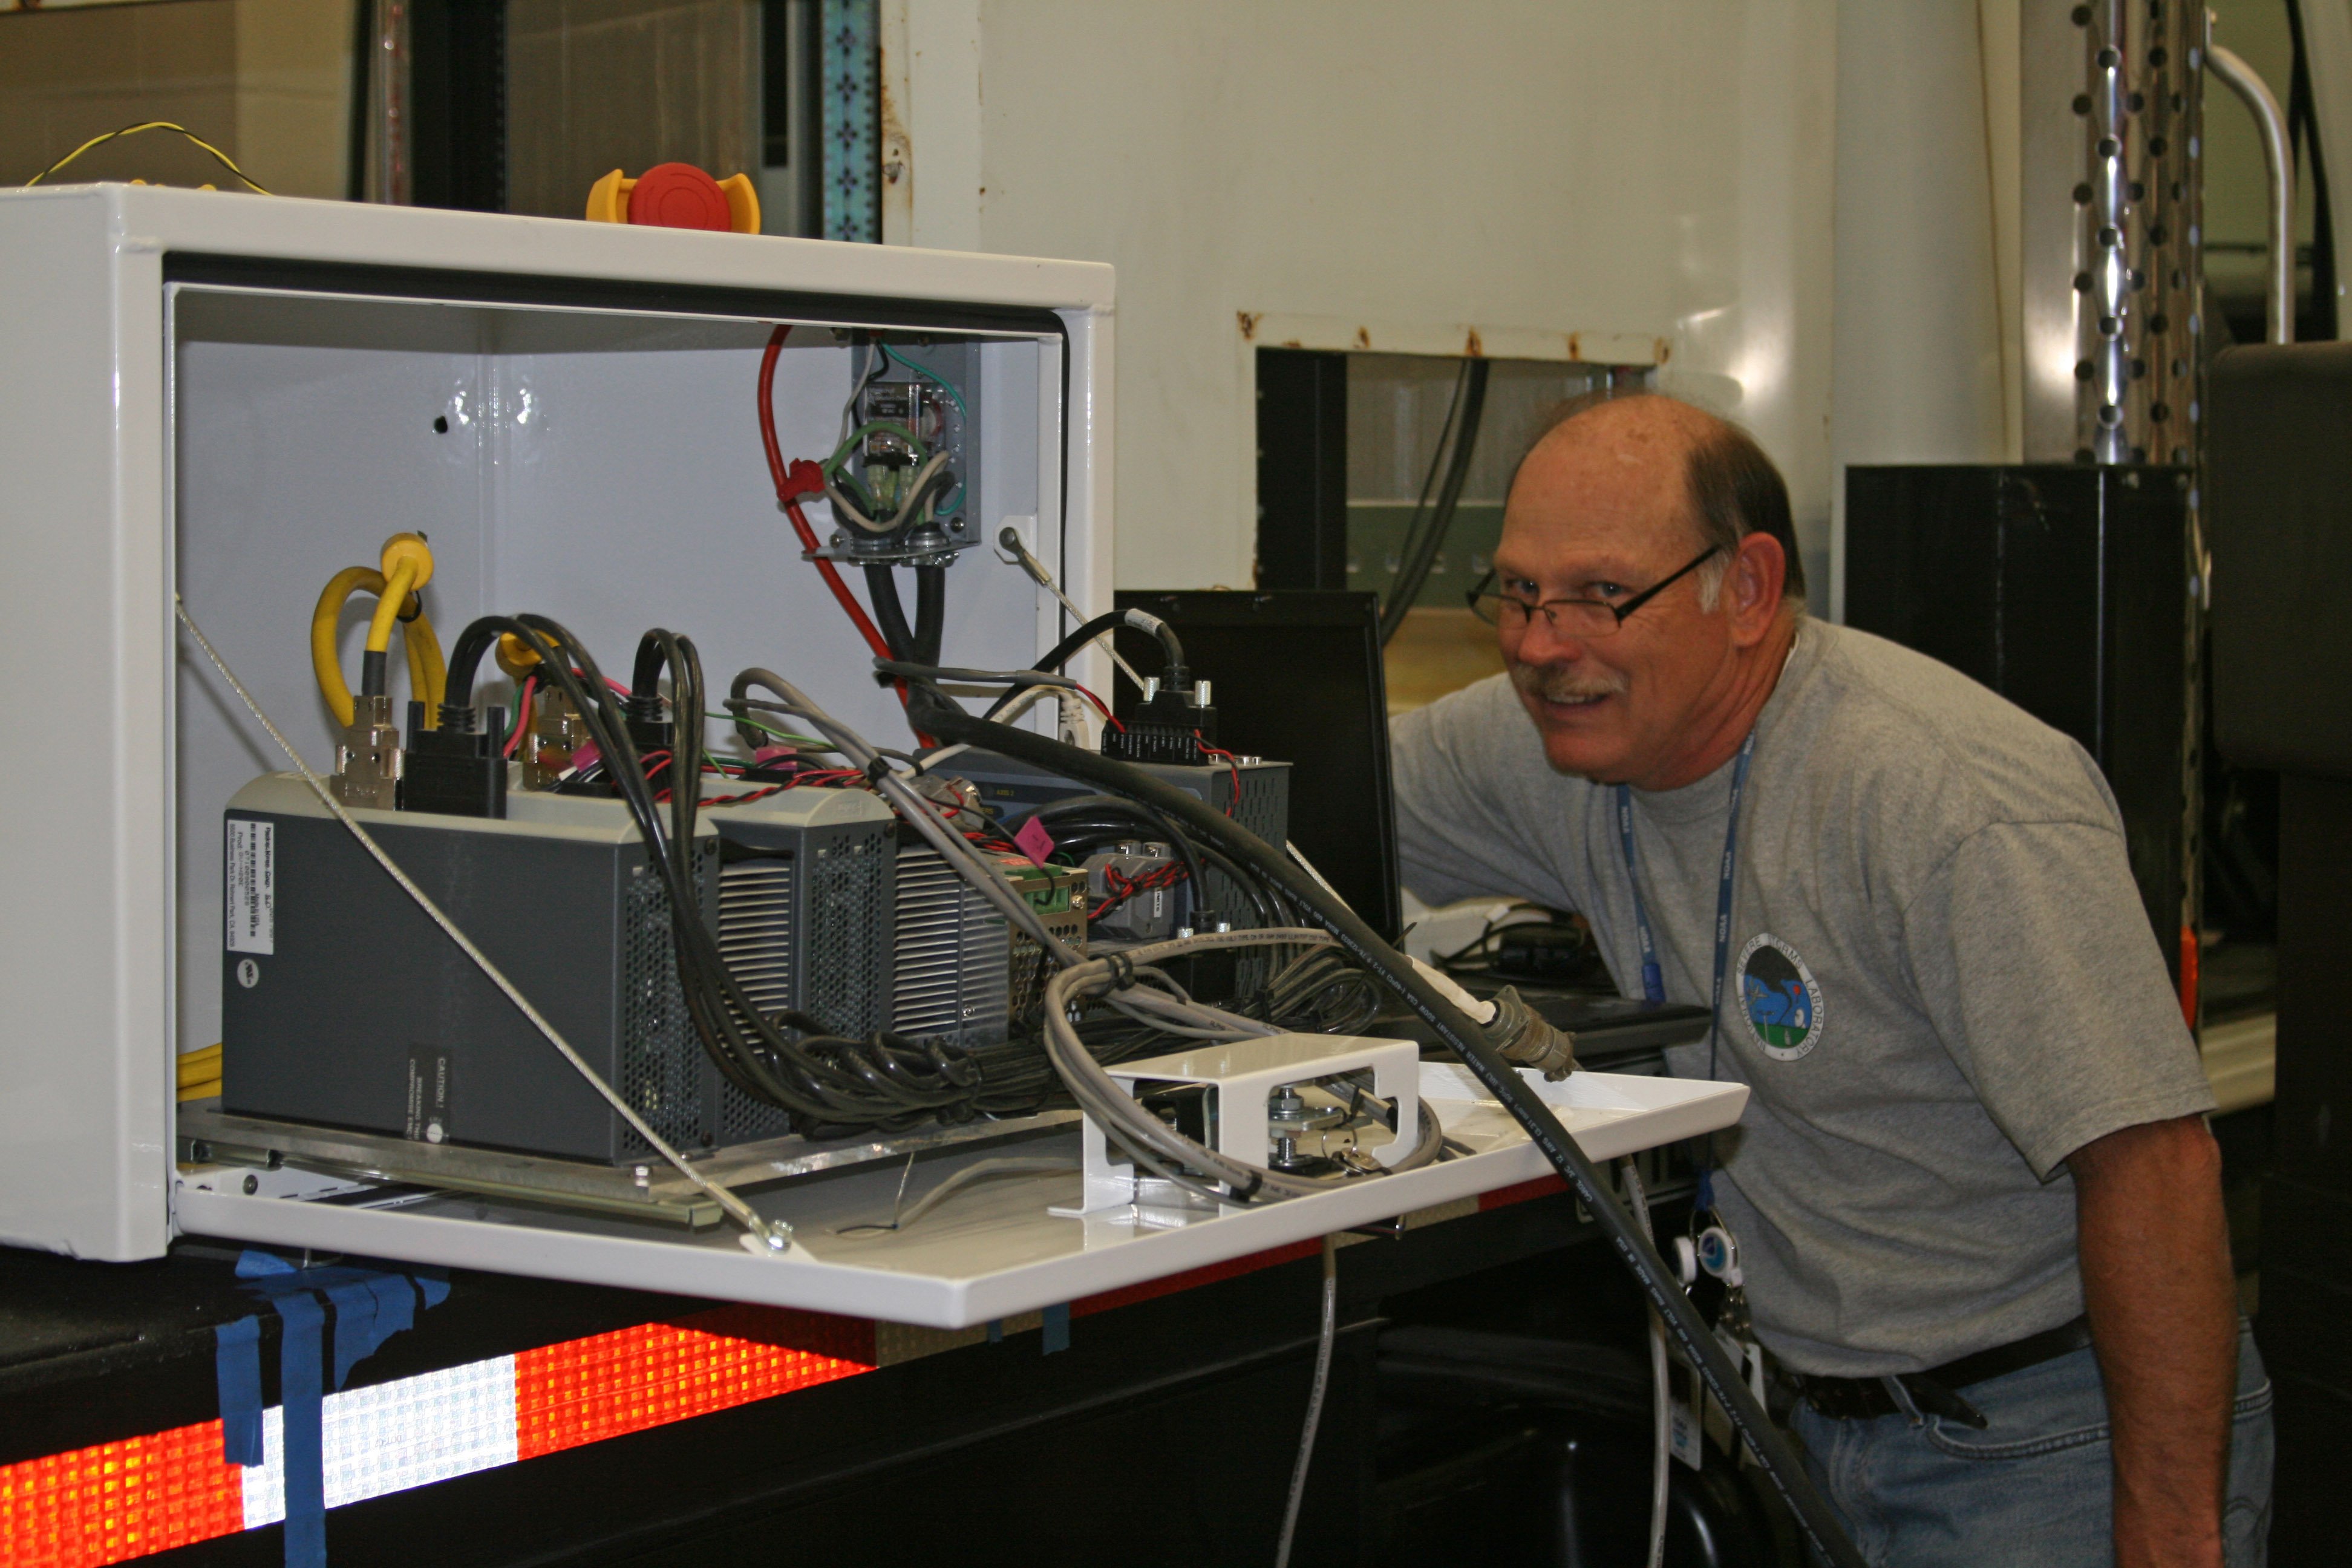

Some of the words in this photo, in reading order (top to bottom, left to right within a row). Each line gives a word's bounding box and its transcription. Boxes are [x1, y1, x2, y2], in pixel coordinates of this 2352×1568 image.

[1723, 852, 1732, 880] NOAA
[1719, 914, 1728, 943] NOAA
[1406, 992, 1418, 1005] CSA
[1737, 936, 1762, 973] SEVERE
[1768, 935, 1804, 969] STORMS
[1797, 978, 1823, 1058] LABORATORY
[1419, 1004, 1436, 1022] SOOW
[1437, 1020, 1465, 1053] RESISTANT
[1466, 1050, 1485, 1072] WATER
[1541, 1137, 1556, 1153] AWG
[1555, 1154, 1564, 1163] 12
[1575, 1180, 1593, 1201] CAROL
[1616, 1236, 1628, 1251] USA
[1634, 1264, 1651, 1284] MADE
[1664, 1308, 1678, 1325] VOLT
